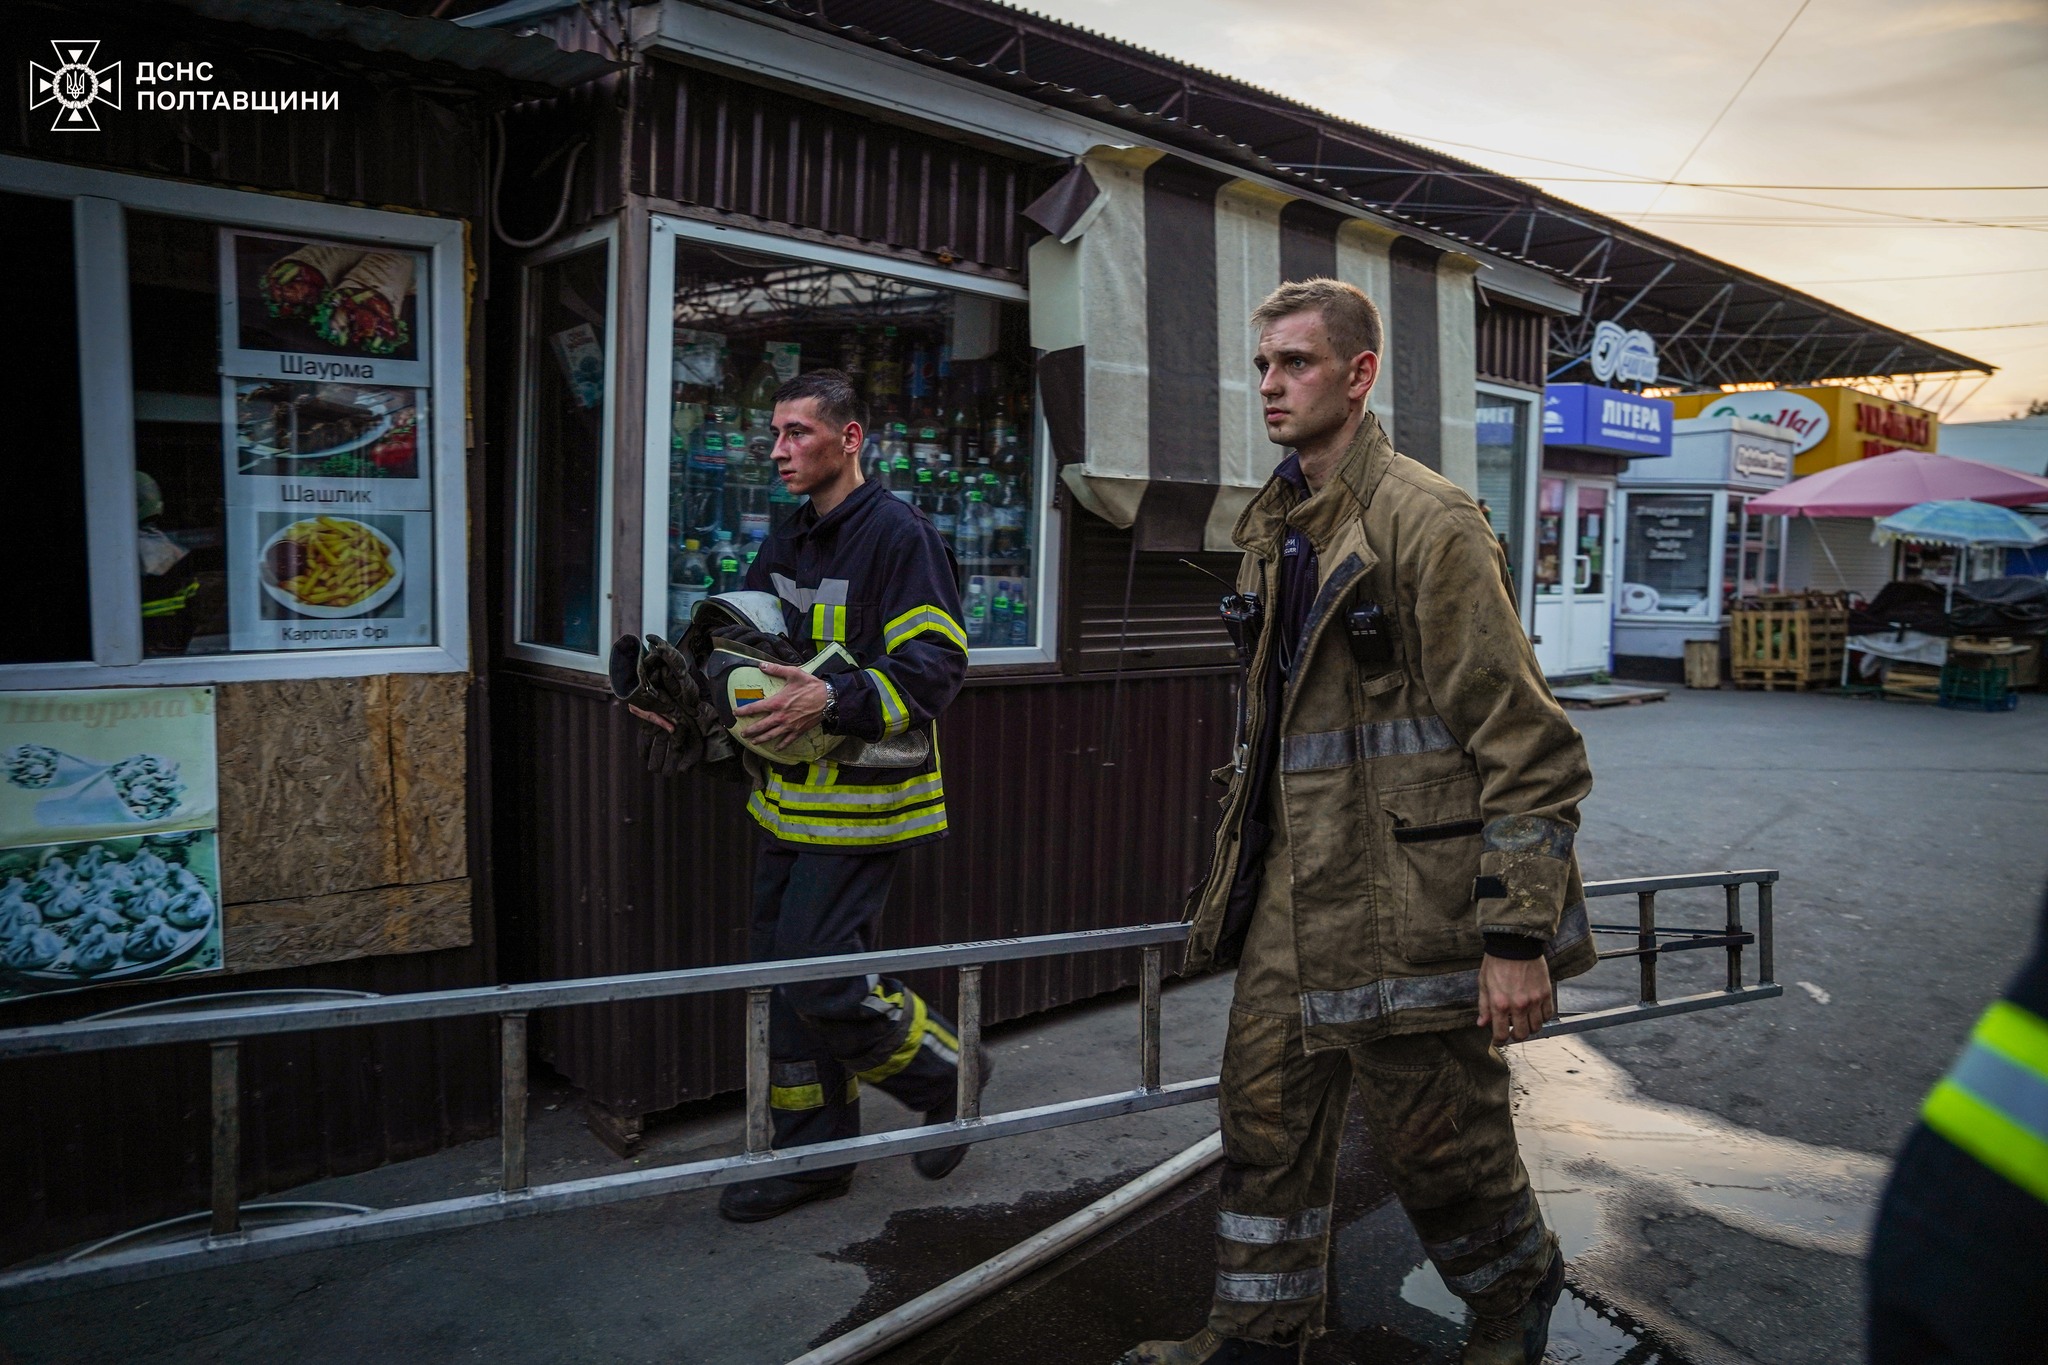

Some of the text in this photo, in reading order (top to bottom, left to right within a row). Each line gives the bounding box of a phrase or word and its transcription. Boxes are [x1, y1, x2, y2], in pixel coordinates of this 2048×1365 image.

[279, 354, 375, 381] Шаурма
[1601, 398, 1662, 433] ЛІТЕРА
[280, 484, 373, 504] Шашлик
[281, 625, 390, 644] Картопля Фрі
[4, 697, 188, 729] Шаурма
